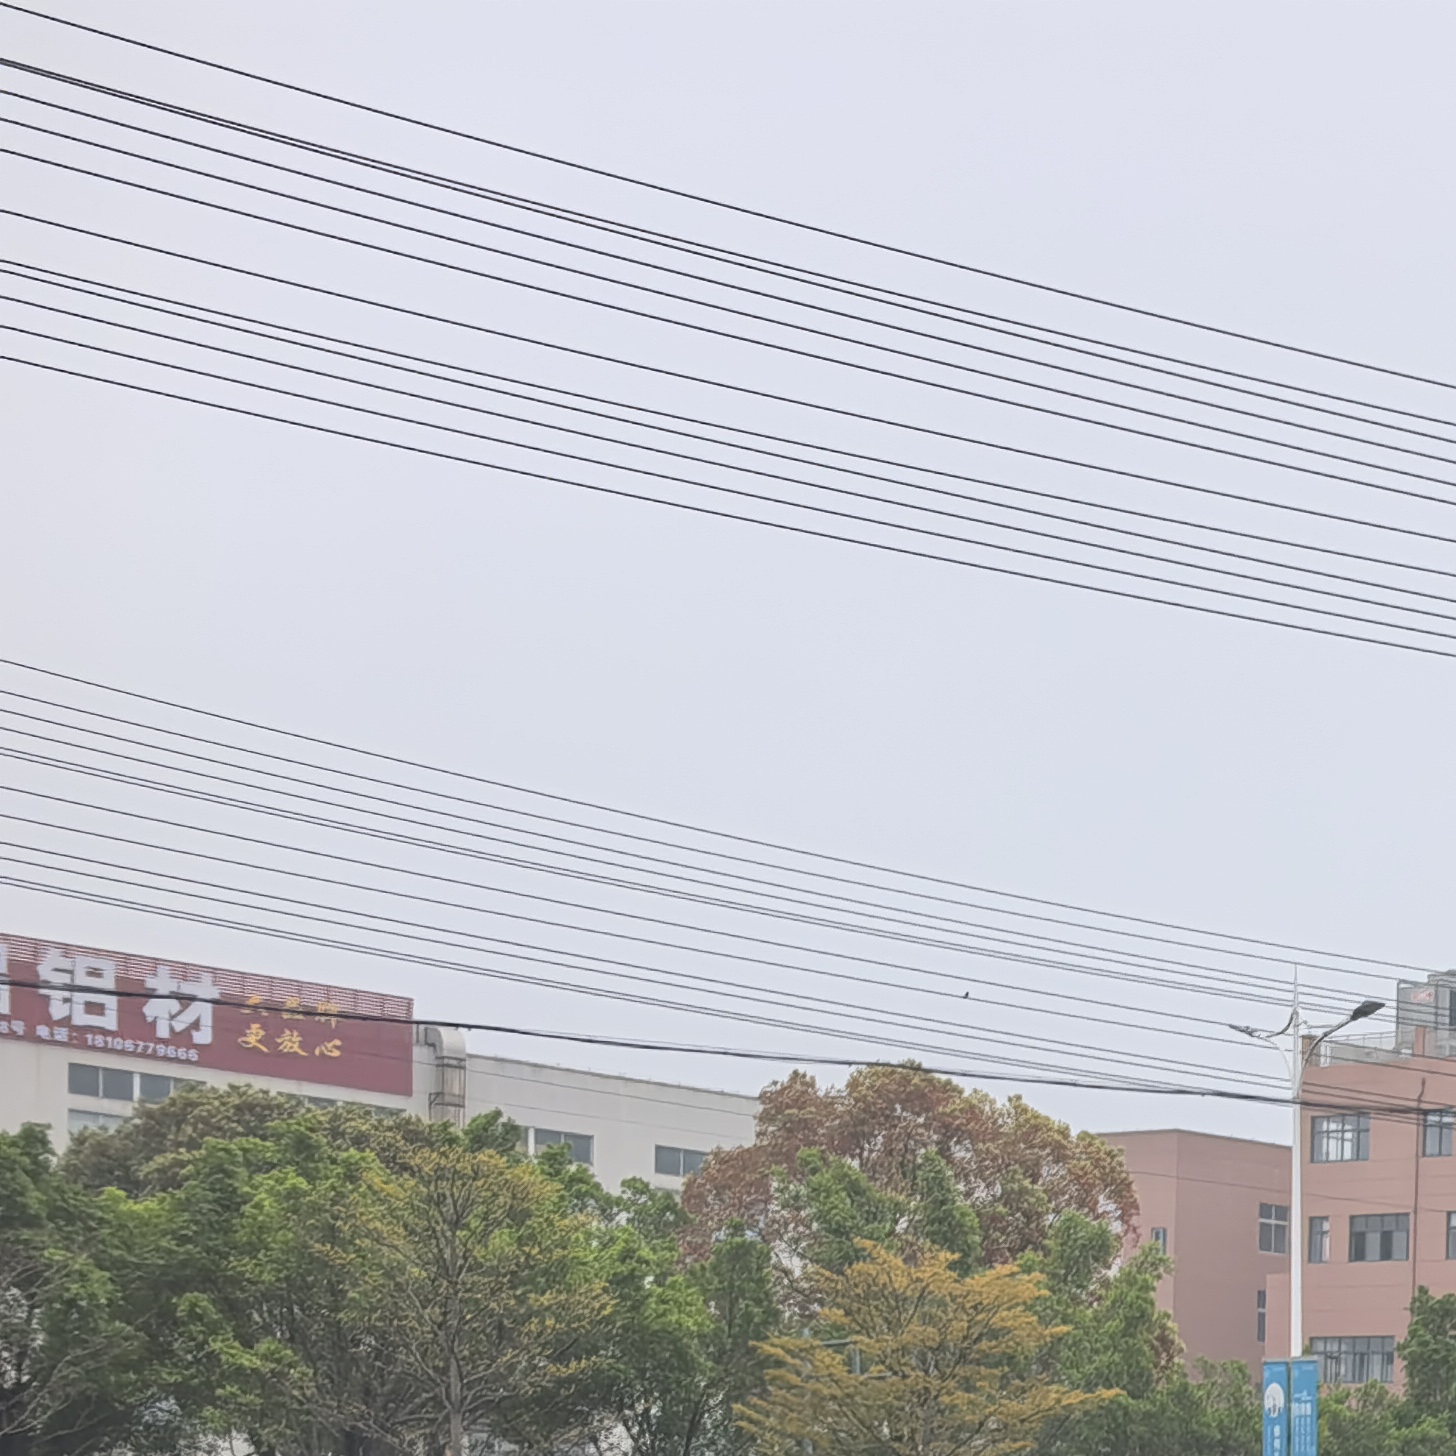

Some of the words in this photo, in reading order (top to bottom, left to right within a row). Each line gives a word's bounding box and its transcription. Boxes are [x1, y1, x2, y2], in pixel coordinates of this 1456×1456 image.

[0, 944, 221, 1045] 铝材
[237, 1023, 342, 1057] 更放心
